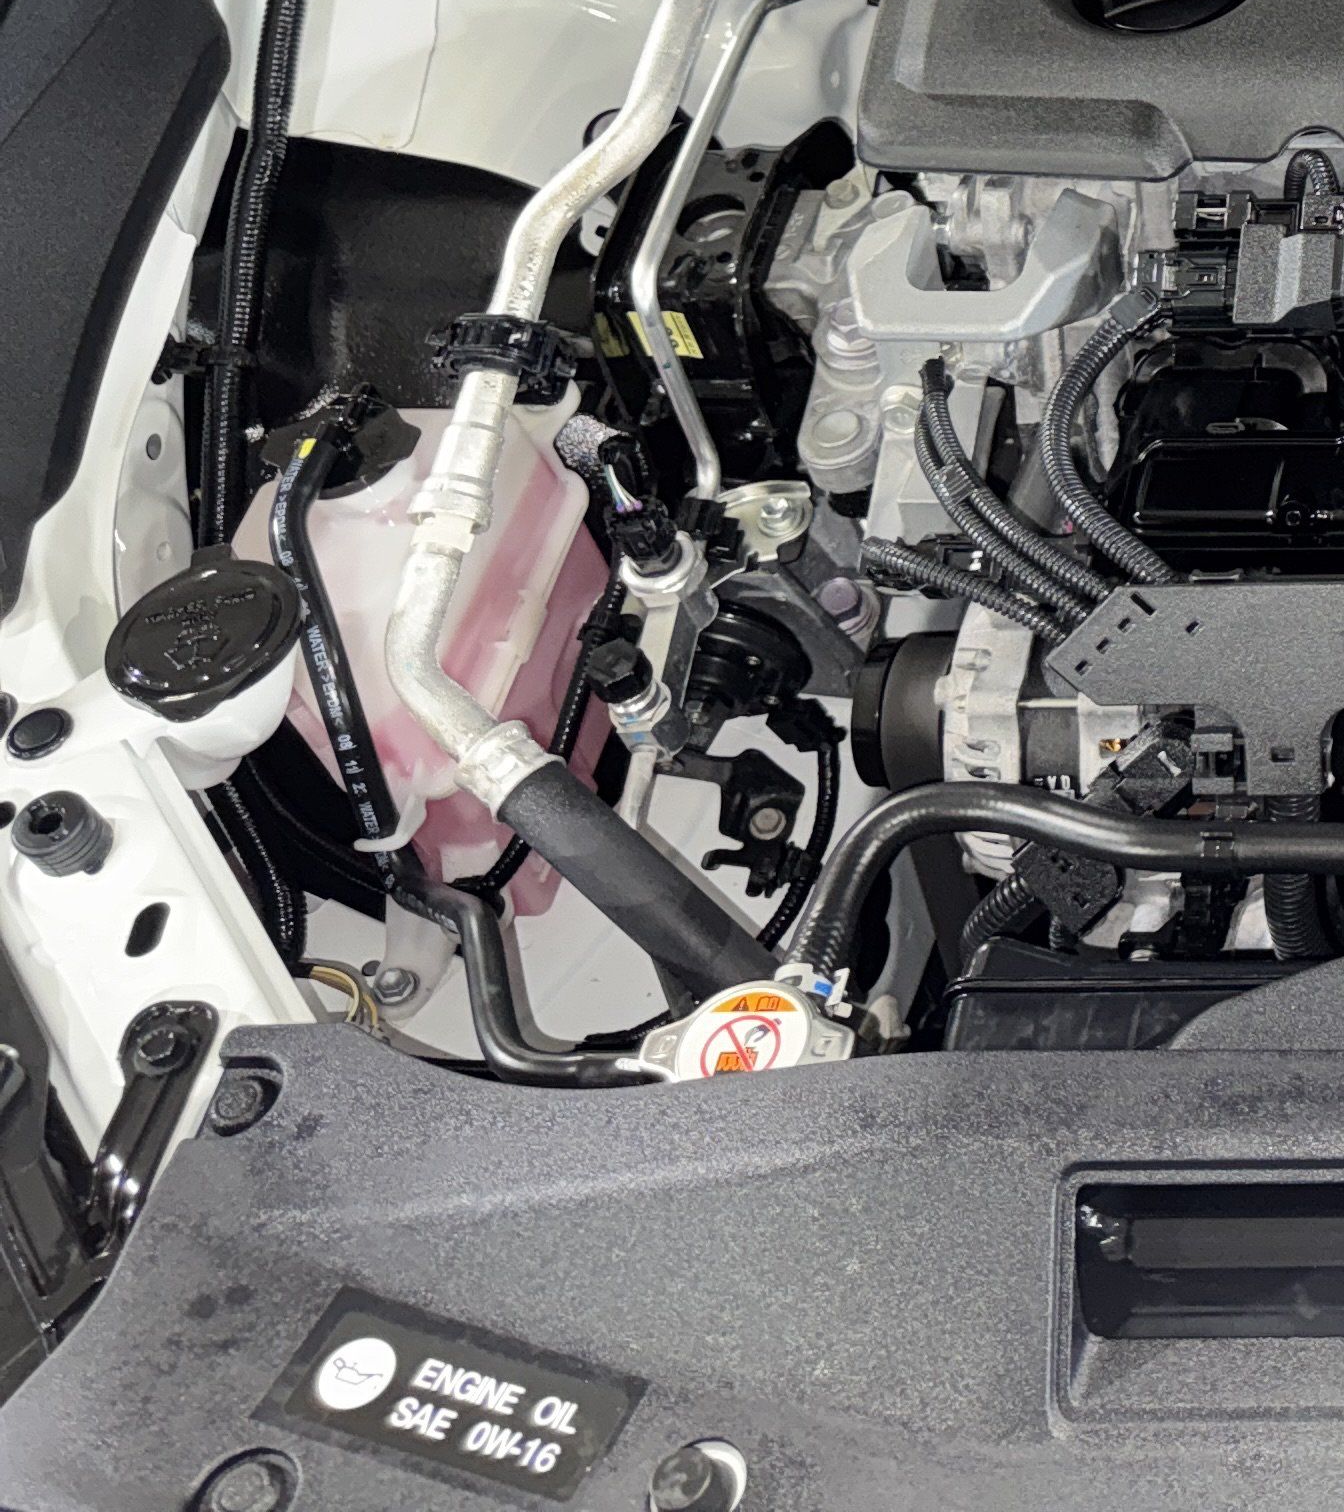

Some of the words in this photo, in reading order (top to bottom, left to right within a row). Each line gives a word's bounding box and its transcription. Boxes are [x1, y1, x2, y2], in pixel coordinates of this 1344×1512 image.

[306, 624, 330, 673] WATER
[358, 800, 381, 835] WATER
[411, 1357, 526, 1416] ENGINE
[532, 1395, 579, 1435] OIL
[384, 1396, 459, 1440] SAE
[464, 1420, 562, 1474] 0W-16
